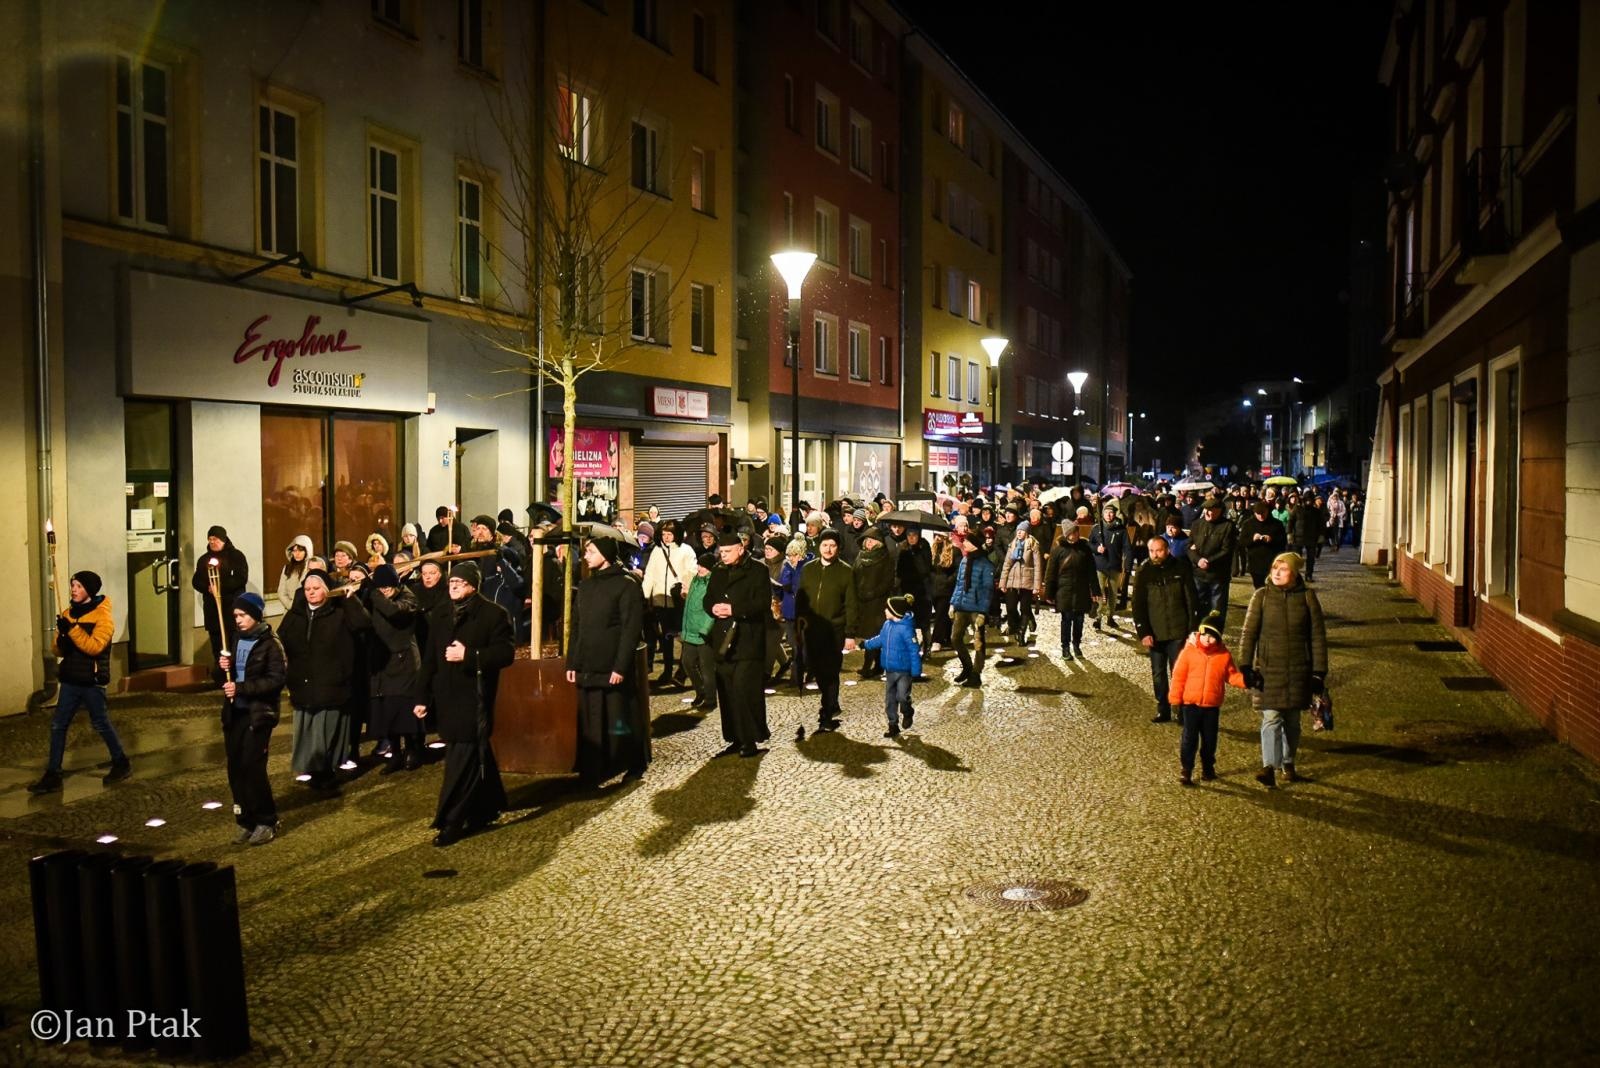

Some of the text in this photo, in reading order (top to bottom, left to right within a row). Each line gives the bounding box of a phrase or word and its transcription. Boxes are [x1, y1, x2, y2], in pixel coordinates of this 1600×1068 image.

[233, 314, 362, 388] Ergoline
[293, 368, 355, 388] ascomsun
[293, 384, 323, 396] STUDIA
